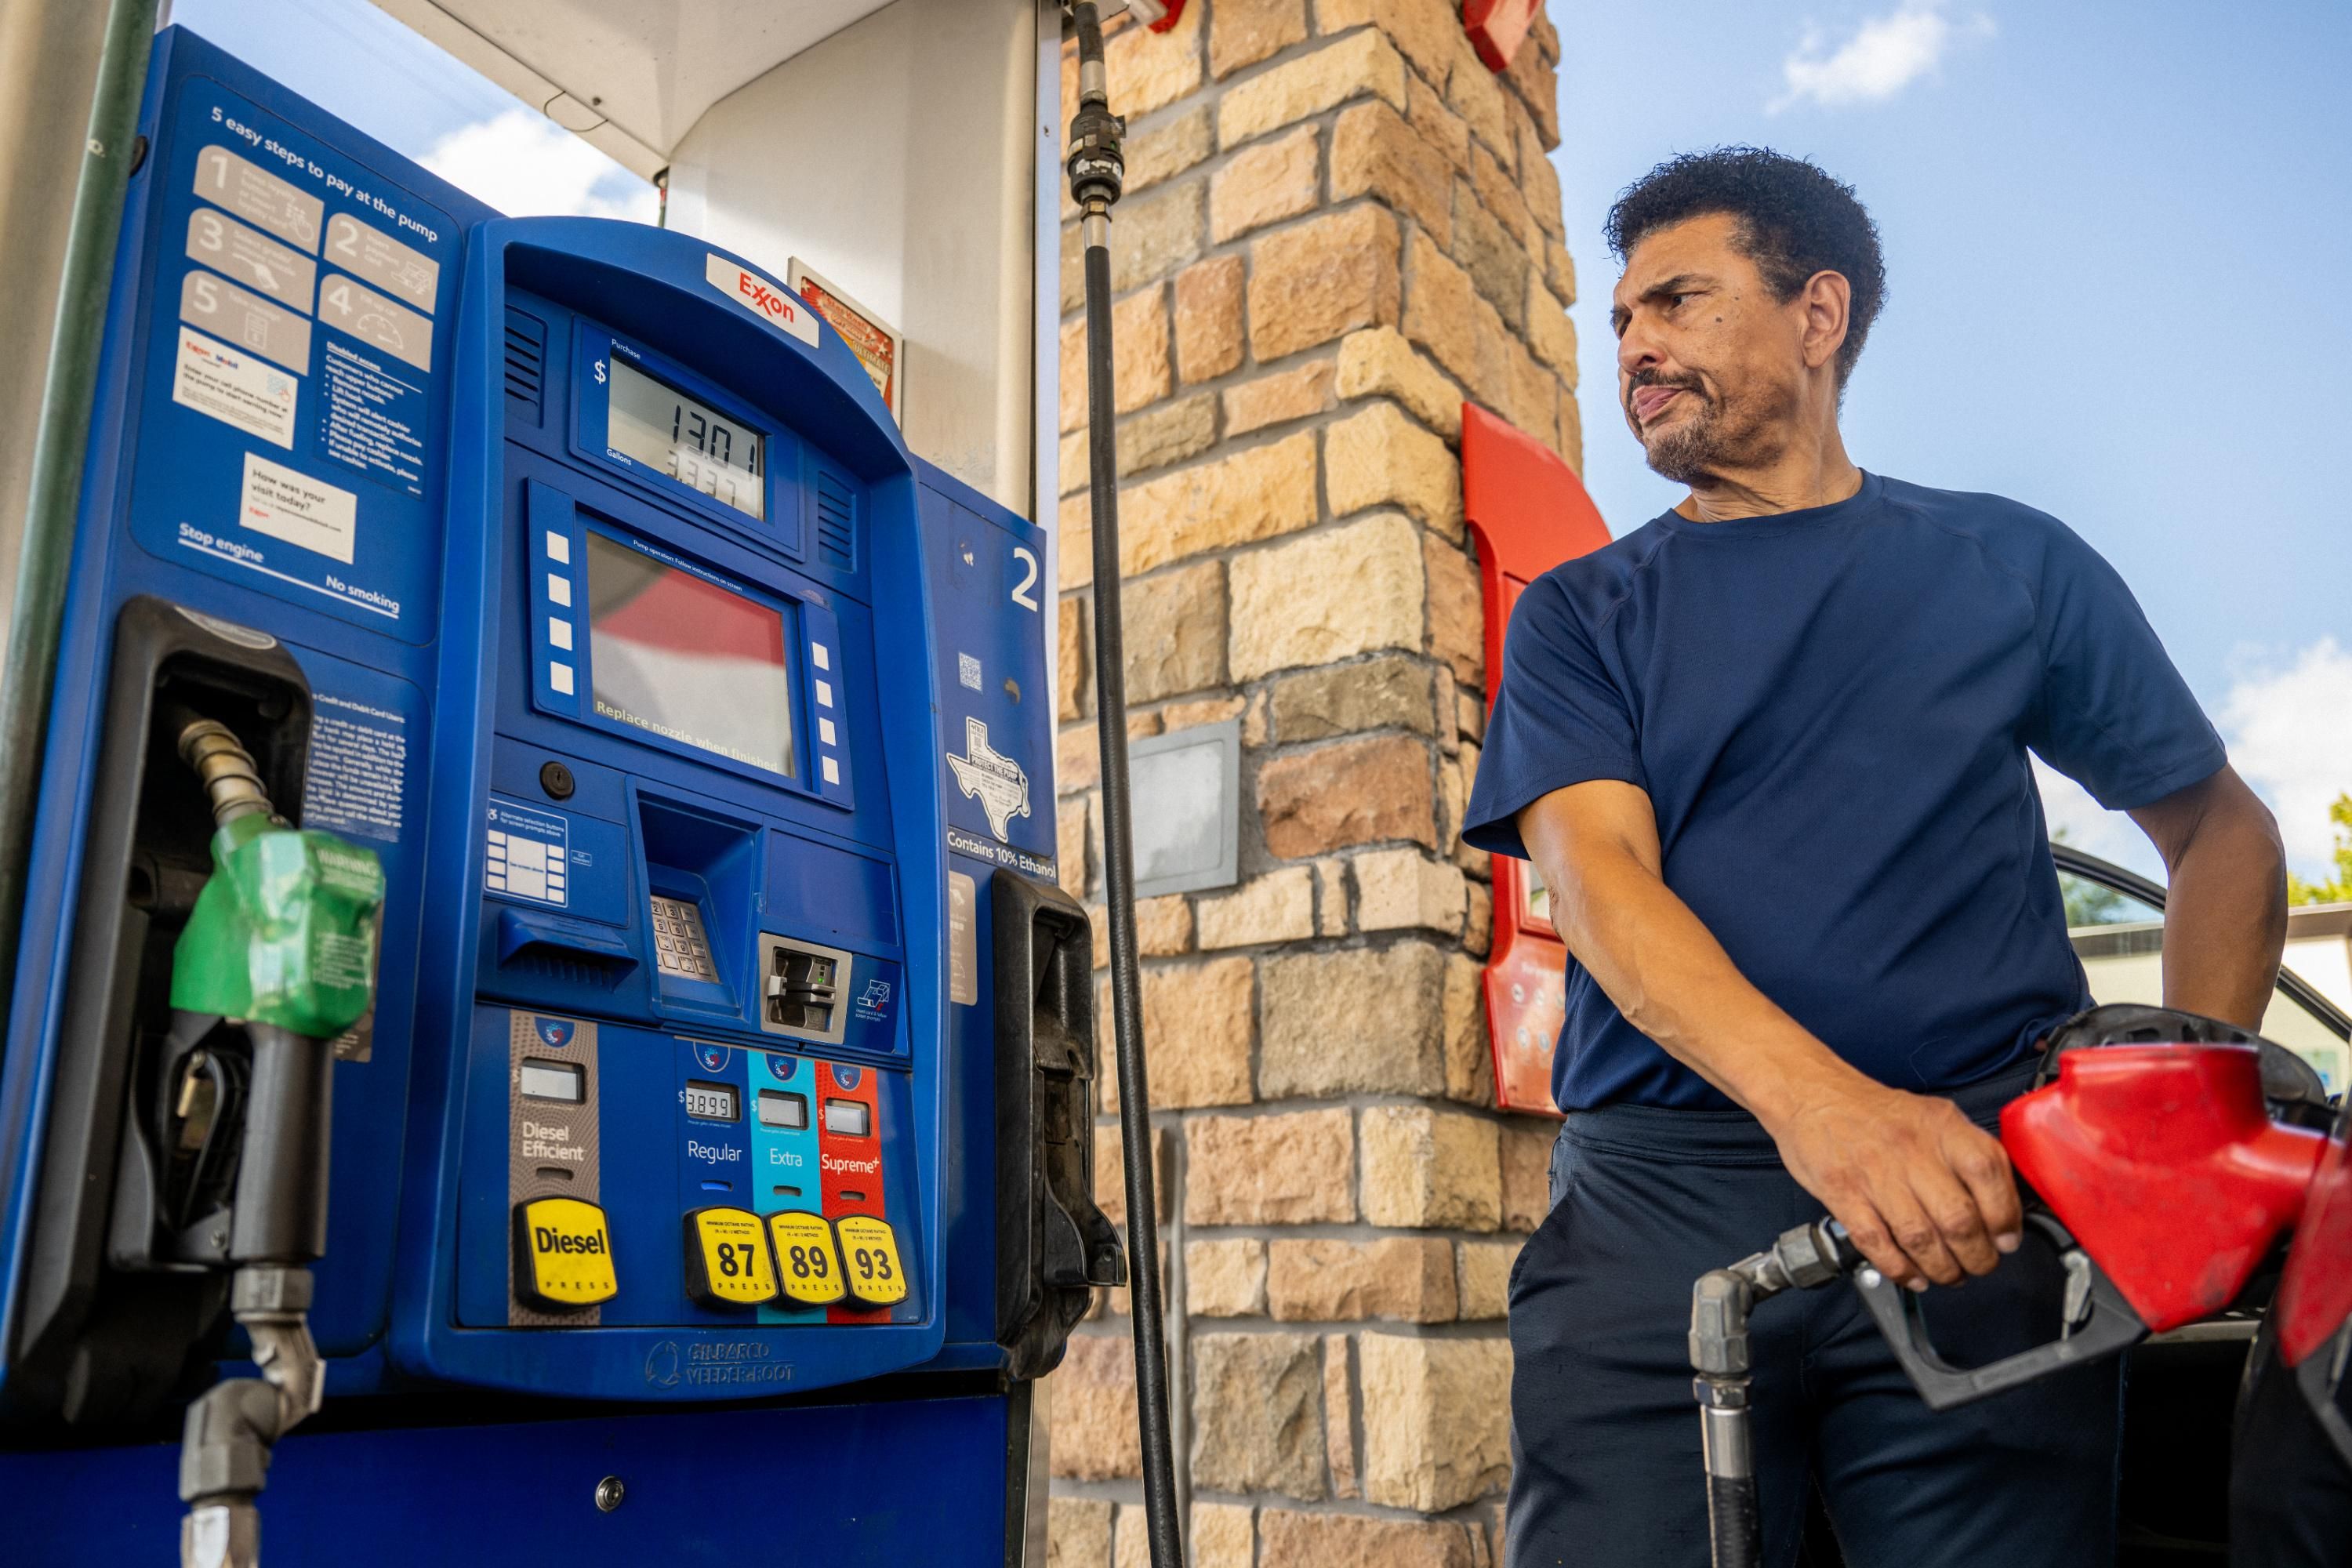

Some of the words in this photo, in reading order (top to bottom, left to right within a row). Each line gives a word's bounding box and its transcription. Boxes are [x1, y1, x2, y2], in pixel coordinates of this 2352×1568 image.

[211, 155, 227, 189] 1
[211, 106, 223, 122] 5
[226, 118, 263, 147] easy
[264, 139, 305, 169] steps
[308, 162, 324, 179] to
[326, 174, 354, 197] pay
[356, 191, 371, 205] at
[373, 198, 396, 219] the
[398, 214, 438, 243] pump
[199, 215, 223, 251] 3
[336, 220, 358, 257] 2
[193, 277, 218, 314] 5
[328, 285, 352, 316] 4
[739, 271, 794, 323] Exxon
[216, 354, 238, 370] Mobil
[327, 341, 358, 360] Disabled
[612, 339, 641, 360] Purchase
[326, 354, 364, 376] Customers
[332, 376, 361, 394] Remove
[332, 393, 357, 410] System
[594, 359, 607, 385] $
[673, 405, 756, 481] 13.01
[329, 430, 353, 445] Please
[607, 449, 631, 466] Gallons
[251, 484, 274, 497] visit
[276, 492, 311, 511] today?
[252, 468, 277, 485] How
[280, 481, 300, 495] was
[303, 489, 326, 504] your
[179, 522, 213, 546] Stop
[216, 537, 264, 563] engine
[325, 574, 347, 592] No
[348, 583, 400, 614] smoking
[633, 539, 649, 551] Pump
[649, 547, 675, 562] operation:
[674, 557, 691, 569] Follow
[691, 565, 720, 582] instructions
[727, 581, 742, 592] screen
[1011, 547, 1038, 612] 2
[597, 701, 649, 728] Replace
[652, 721, 693, 744] nozzle
[695, 738, 728, 756] when
[731, 747, 779, 772] finished
[971, 755, 994, 773] PROTECT
[994, 764, 1004, 775] THE
[1004, 768, 1018, 781] PUMP
[500, 811, 524, 822] Alternate
[524, 818, 546, 827] selection
[546, 822, 564, 833] buttons
[525, 823, 546, 833] prompts
[947, 831, 994, 858] Contains
[996, 848, 1018, 866] 10%
[1019, 855, 1056, 879] Ethanol
[678, 1090, 685, 1103] $
[688, 1094, 728, 1116] 3.899
[751, 1099, 757, 1112] $
[818, 1108, 825, 1120] $
[523, 1121, 569, 1141] Diesel
[523, 1140, 585, 1162] Efficient
[688, 1140, 742, 1164] Regular
[770, 1148, 803, 1167] Extra
[822, 1153, 880, 1175] Supreme+
[535, 1226, 606, 1254] Diesel
[717, 1243, 755, 1277] 87
[789, 1245, 829, 1279] 89
[855, 1247, 893, 1280] 93
[688, 1341, 770, 1361] GILBARCO
[686, 1363, 797, 1386] VEEDER-ROOT
